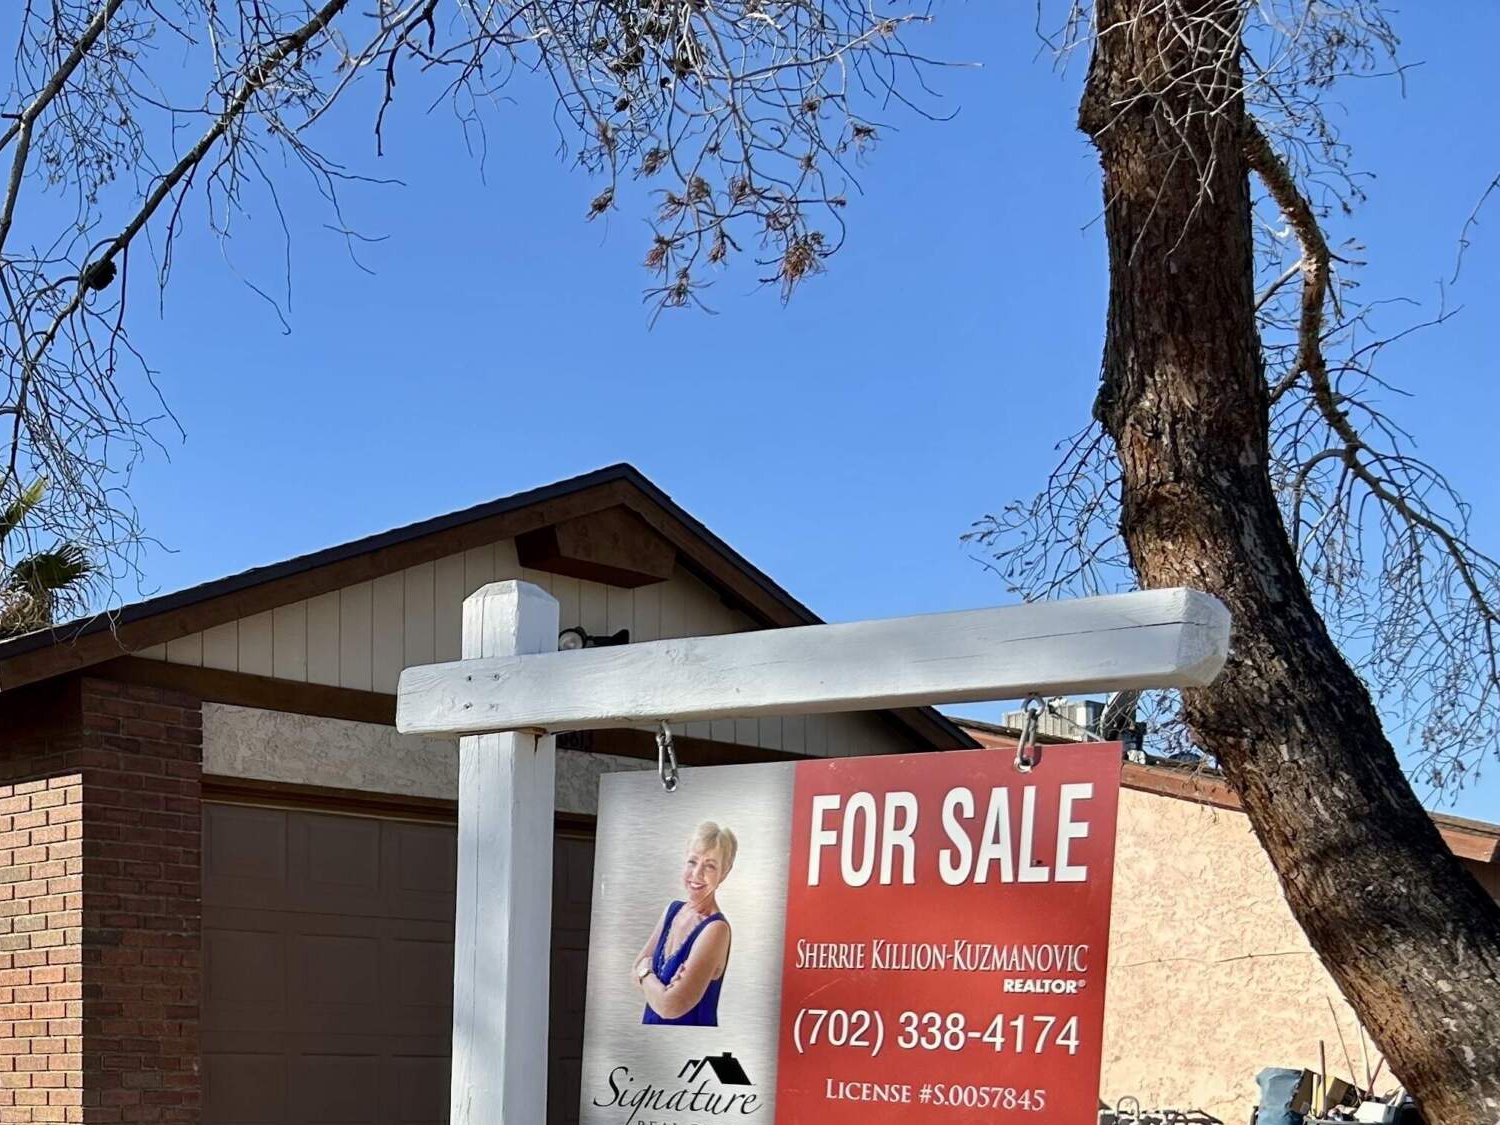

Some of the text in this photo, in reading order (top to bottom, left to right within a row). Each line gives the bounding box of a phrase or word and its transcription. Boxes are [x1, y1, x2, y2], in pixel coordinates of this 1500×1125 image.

[807, 782, 1094, 887] FOR SALE
[795, 938, 1089, 973] SHERRIE KILLION-KUZMANOVIC
[793, 1008, 1081, 1057] (702) 338-4174
[825, 1078, 1046, 1112] LICENSE #S.0057845
